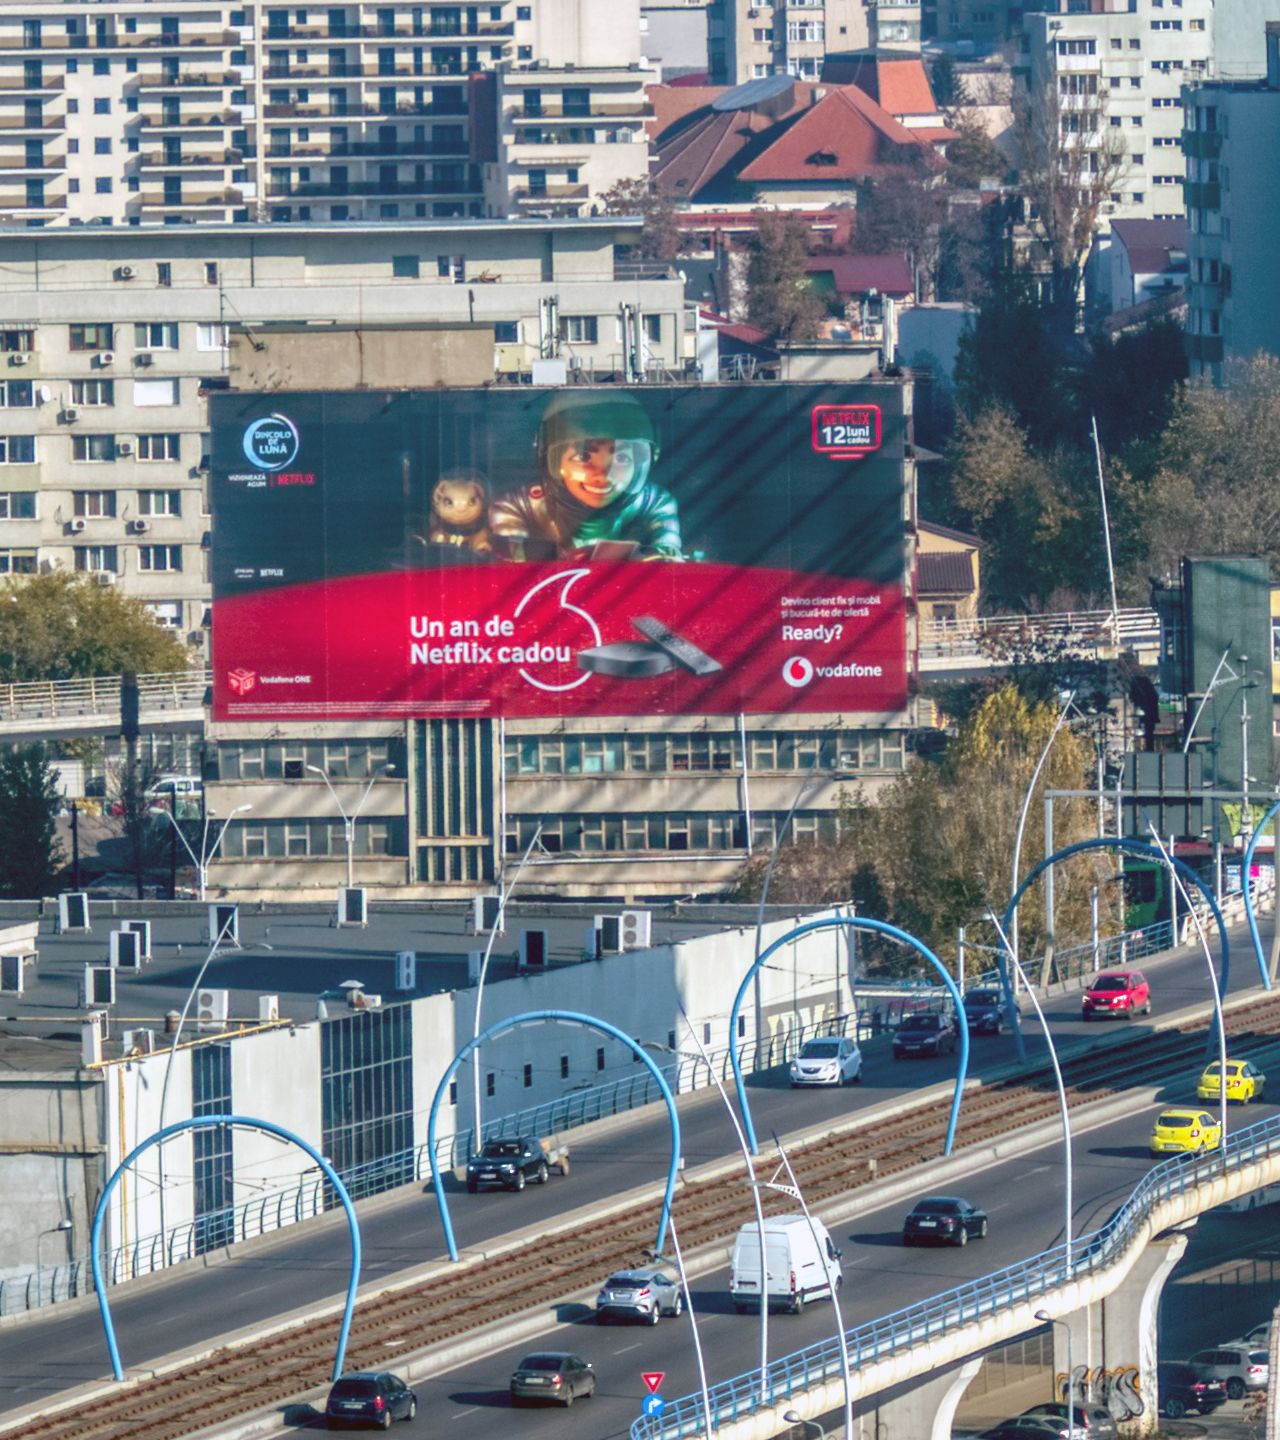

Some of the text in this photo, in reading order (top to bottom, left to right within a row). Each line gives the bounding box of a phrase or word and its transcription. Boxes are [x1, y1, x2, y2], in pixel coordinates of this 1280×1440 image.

[822, 411, 869, 425] NETFLIX
[255, 431, 291, 439] DINCOLO
[822, 426, 869, 444] 12 luni
[278, 473, 315, 485] NETFLIX
[411, 615, 515, 637] Un an de
[782, 625, 843, 643] Ready?
[411, 641, 570, 664] Netflix cadou
[816, 664, 882, 677] vodafone
[260, 675, 312, 684] Vodafone ONE
